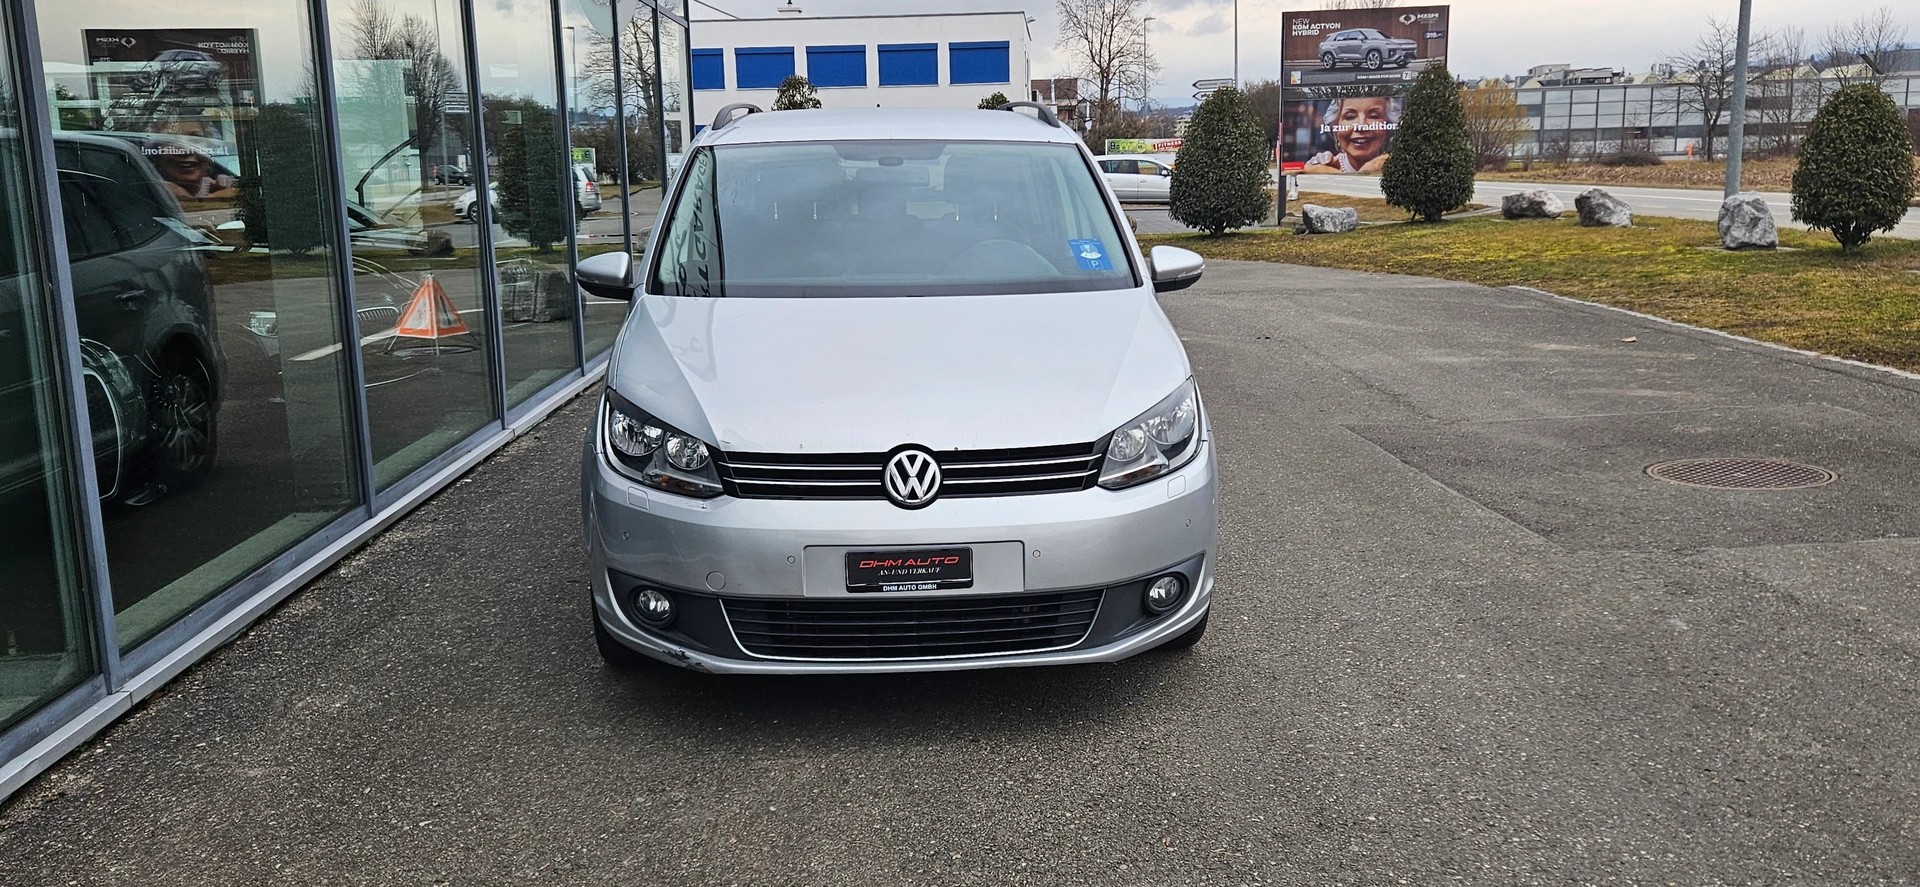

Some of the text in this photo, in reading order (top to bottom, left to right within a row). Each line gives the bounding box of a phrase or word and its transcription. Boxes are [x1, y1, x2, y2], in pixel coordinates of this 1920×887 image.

[1310, 22, 1341, 30] ACTYON
[1292, 29, 1320, 37] HYBRID
[1320, 124, 1331, 134] Ja
[1332, 124, 1351, 132] zur
[859, 556, 959, 569] DHM AUTO
